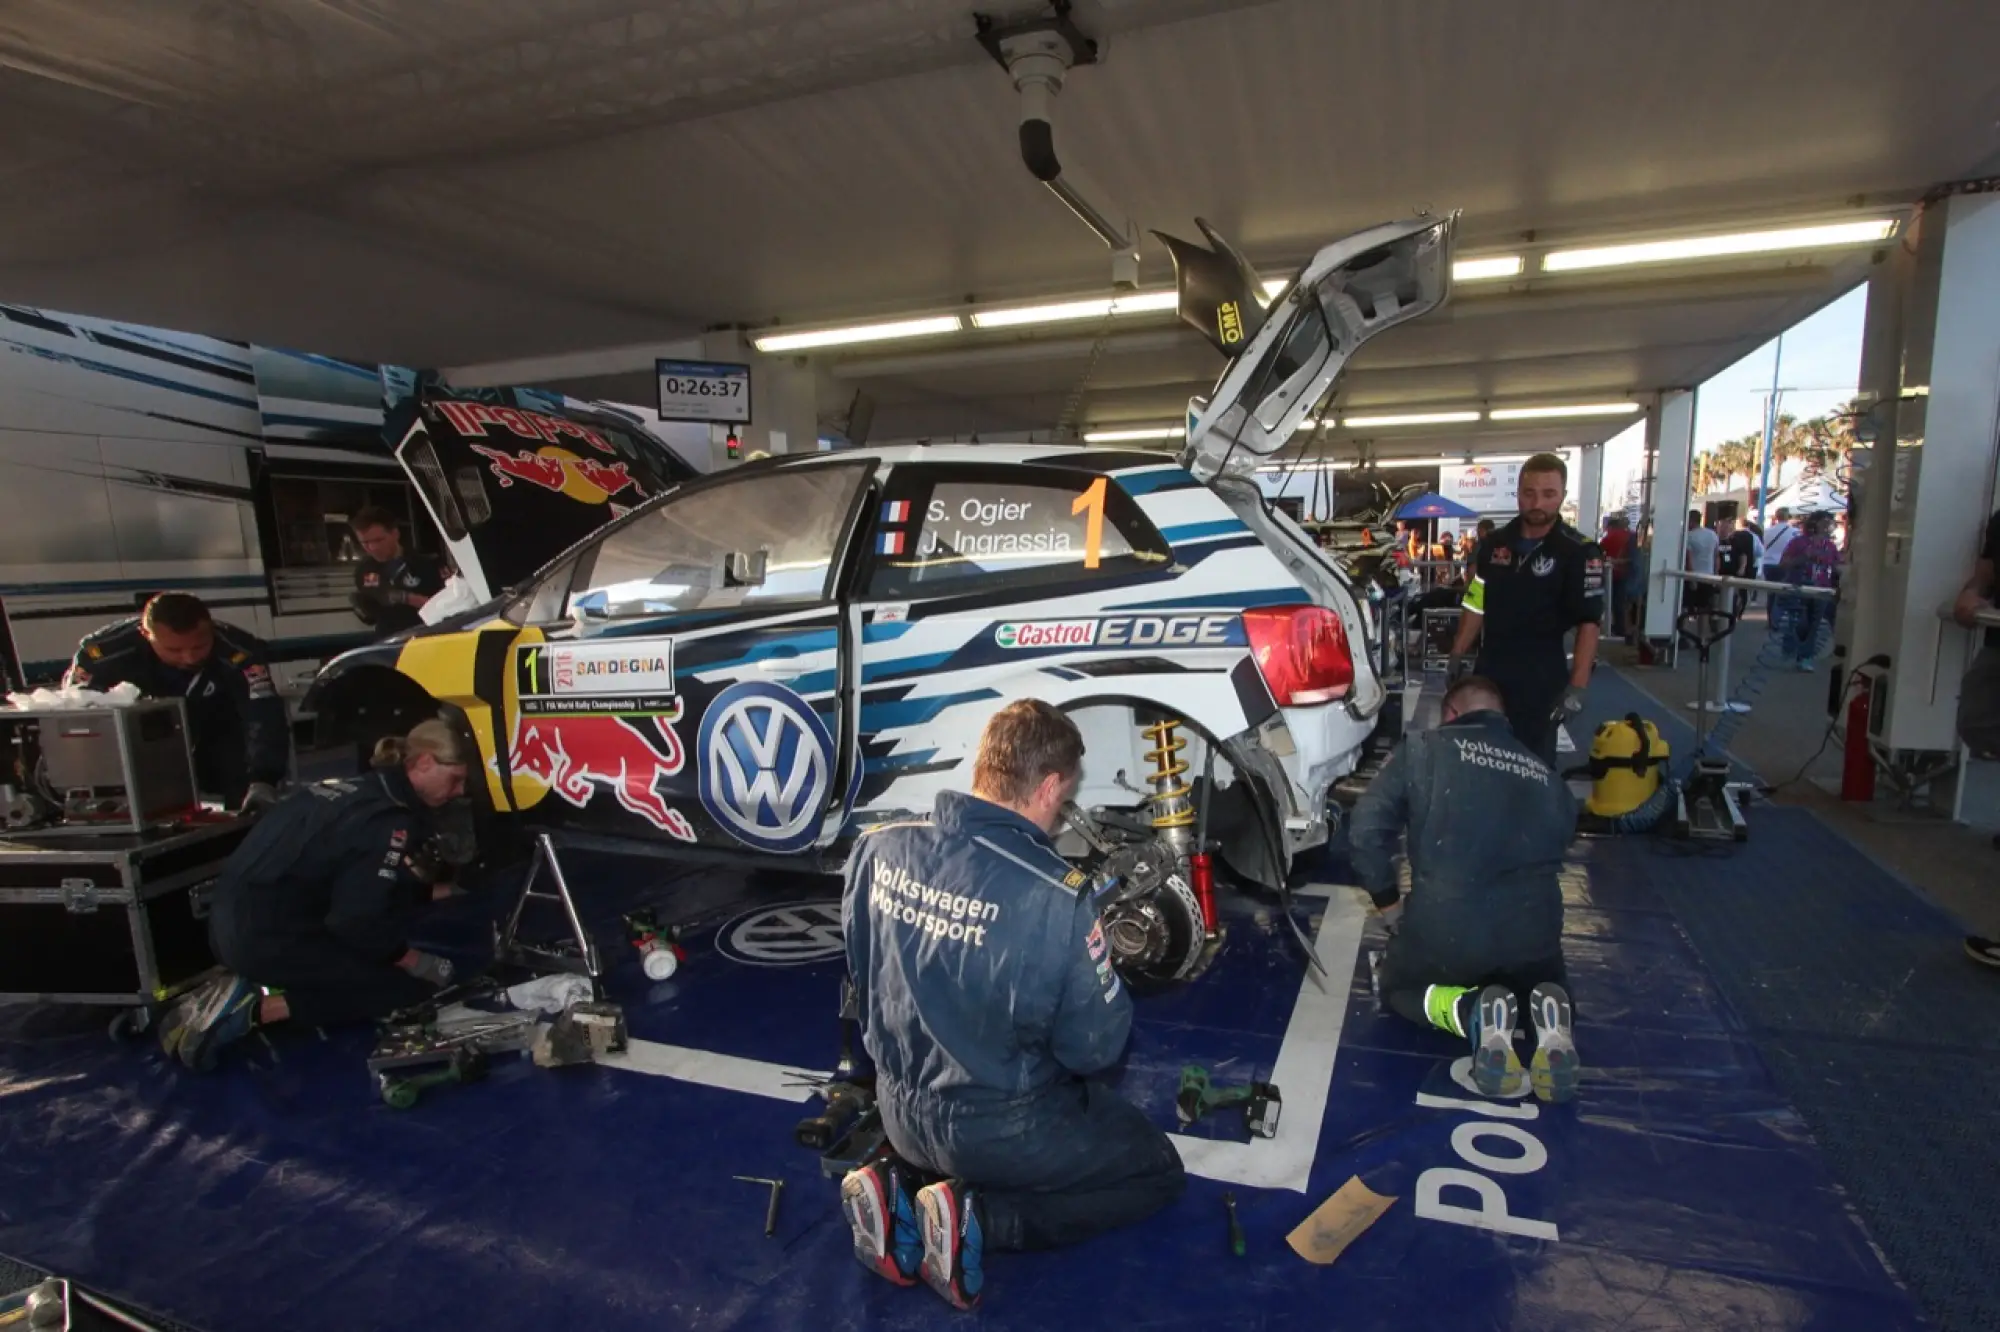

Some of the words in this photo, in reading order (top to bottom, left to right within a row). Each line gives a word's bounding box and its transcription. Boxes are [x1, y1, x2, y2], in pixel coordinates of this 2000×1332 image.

[1221, 302, 1240, 343] OMP
[666, 377, 742, 398] 0:26:37
[433, 401, 542, 439] Bull
[1458, 478, 1476, 488] Red
[1477, 478, 1497, 488] Bull
[926, 499, 950, 522] S.
[960, 498, 1032, 527] Ogier
[1071, 477, 1107, 569] 1
[923, 531, 943, 554] J.
[954, 528, 1071, 555] Ingrassia
[1017, 622, 1092, 646] Castrol
[1097, 616, 1230, 645] EDGE
[525, 648, 538, 694] 1
[576, 657, 665, 676] SARDEGNA
[592, 700, 635, 711] Championship
[1454, 737, 1550, 775] Volkswagen
[1460, 750, 1550, 787] Motorsport
[873, 857, 1000, 922] Volkswagen
[871, 884, 987, 947] Motorsport
